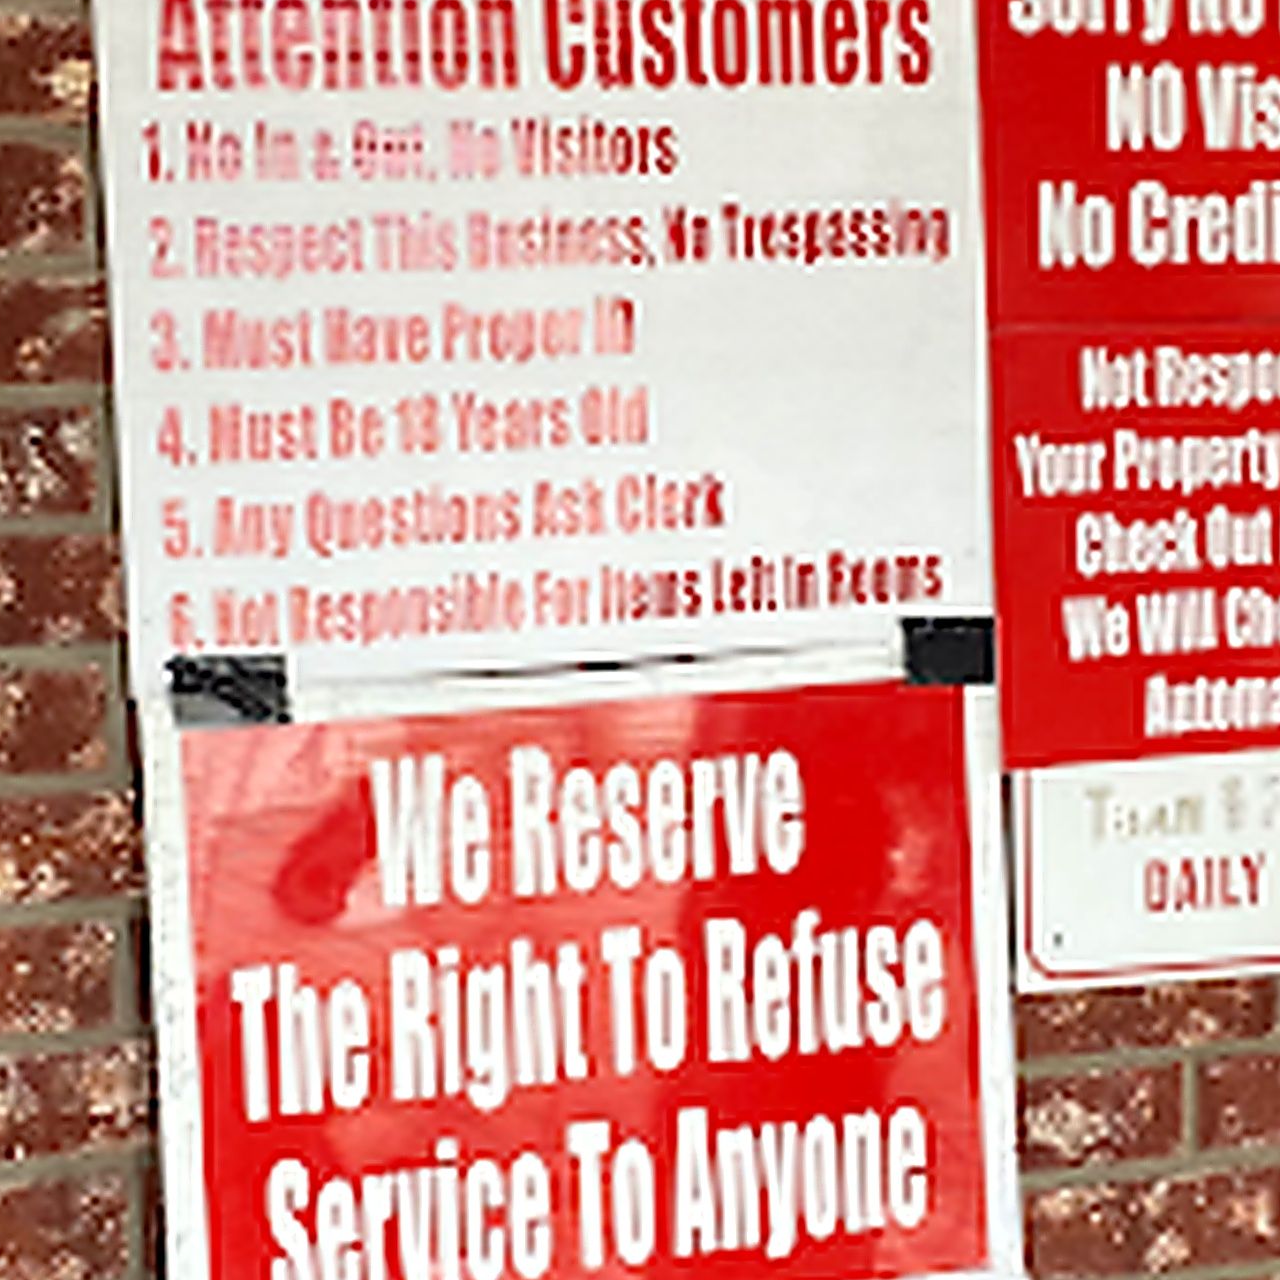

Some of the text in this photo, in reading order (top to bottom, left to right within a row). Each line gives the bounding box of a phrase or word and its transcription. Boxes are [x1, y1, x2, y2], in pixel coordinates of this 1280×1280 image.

[1105, 61, 1187, 151] NO
[141, 121, 174, 182] 1.
[185, 121, 243, 180] No
[254, 121, 302, 180] In
[449, 120, 501, 178] No
[511, 118, 679, 177] Visitors
[148, 217, 184, 279] 2.
[193, 215, 364, 279] Respect
[373, 210, 459, 272] This
[663, 205, 710, 262] No
[720, 202, 952, 267] Trespassing
[1037, 179, 1115, 269] No
[150, 297, 636, 372] 3. Must Have Proper ID
[1080, 346, 1151, 410] Not
[157, 386, 650, 467] 4. Must Be 18 Years Old
[1015, 432, 1106, 497] Your
[162, 474, 726, 561] 5. Any Questions Ask Clerk
[1075, 509, 1200, 578] Check
[1205, 505, 1272, 567] Out
[215, 588, 281, 649] Not
[290, 574, 525, 649] Responsible
[533, 569, 590, 630] For
[599, 561, 703, 624] Items
[713, 555, 777, 614] Left
[784, 555, 819, 609] In
[828, 551, 944, 608] Rooms
[1062, 594, 1129, 661] We
[1136, 587, 1218, 655] Will
[372, 745, 806, 907] We Reserve
[1143, 851, 1267, 913] DAILY
[231, 909, 945, 1123] The Right To Refuse
[564, 1119, 656, 1270] To
[674, 1104, 928, 1259] Anyone
